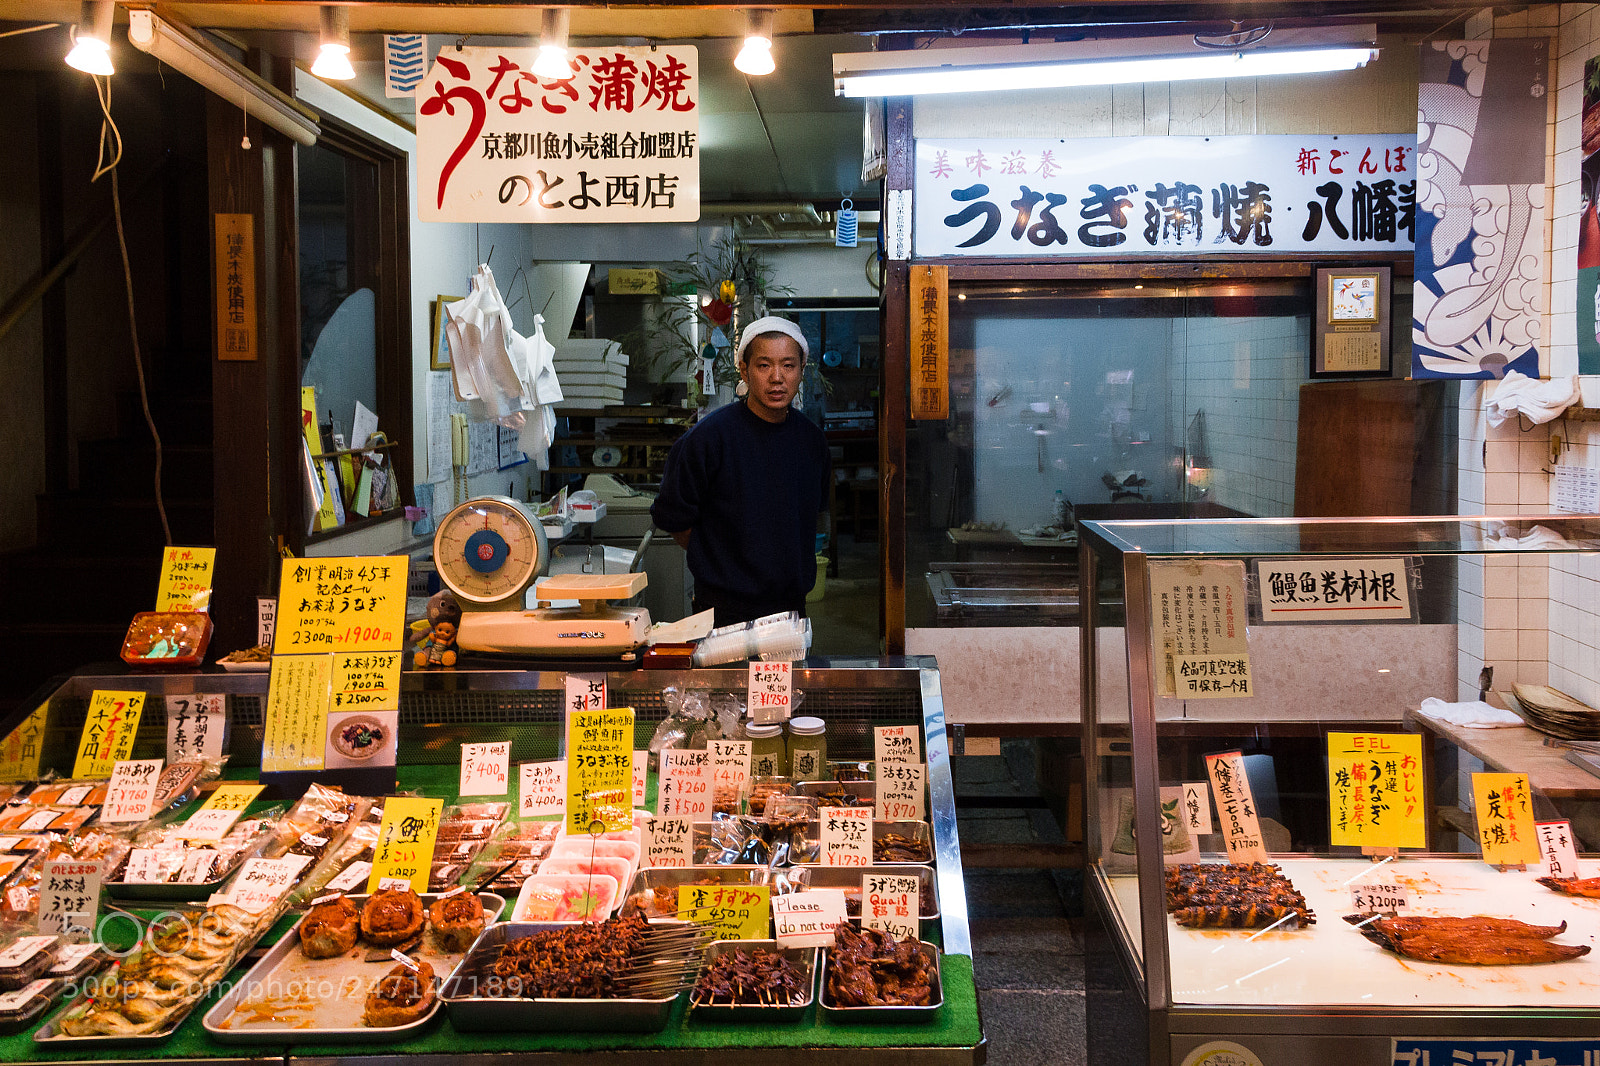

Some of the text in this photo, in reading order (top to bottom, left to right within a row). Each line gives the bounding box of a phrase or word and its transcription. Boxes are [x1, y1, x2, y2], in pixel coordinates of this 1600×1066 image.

[420, 53, 695, 210] うなぎ蒲焼
[481, 131, 696, 160] 京都川魚小売組合加盟店
[930, 148, 1063, 179] 美味滋養
[1295, 146, 1412, 176] 新ごんぼ
[498, 169, 679, 210] のとよ西店
[943, 181, 1274, 249] うなぎ蒲焼
[920, 286, 938, 383] 備長木炭使用店
[291, 565, 391, 583] 創業明治45年
[316, 583, 373, 596] 記念セール
[298, 595, 386, 614] お茶漬うなぎ
[299, 617, 335, 627] 100グラム
[100, 701, 125, 760] フナ寿司
[714, 743, 748, 757] えび豆
[884, 737, 912, 747] こあゆ
[1353, 736, 1391, 750] EEL
[882, 766, 920, 780] 活もろこ
[1384, 760, 1398, 792] 特選
[676, 779, 706, 794] ¥260
[1368, 759, 1390, 826] うなぎ
[1515, 776, 1527, 813] すべて
[674, 798, 705, 814] ¥500
[1334, 767, 1351, 832] 焼いています
[1349, 762, 1368, 833] 備長炭で
[882, 802, 916, 820] ¥870
[1501, 786, 1520, 843] 備長炭
[646, 818, 689, 835] すっぽん
[827, 819, 868, 832] 本もろこ
[1482, 828, 1491, 850] です
[648, 847, 683, 856] 100グラム
[388, 867, 417, 878] CARP
[712, 887, 761, 908] すずめ
[776, 897, 821, 912] Please
[869, 893, 908, 906] Quail
[709, 907, 750, 920] 450円
[779, 915, 796, 935] do
[800, 922, 817, 932] not
